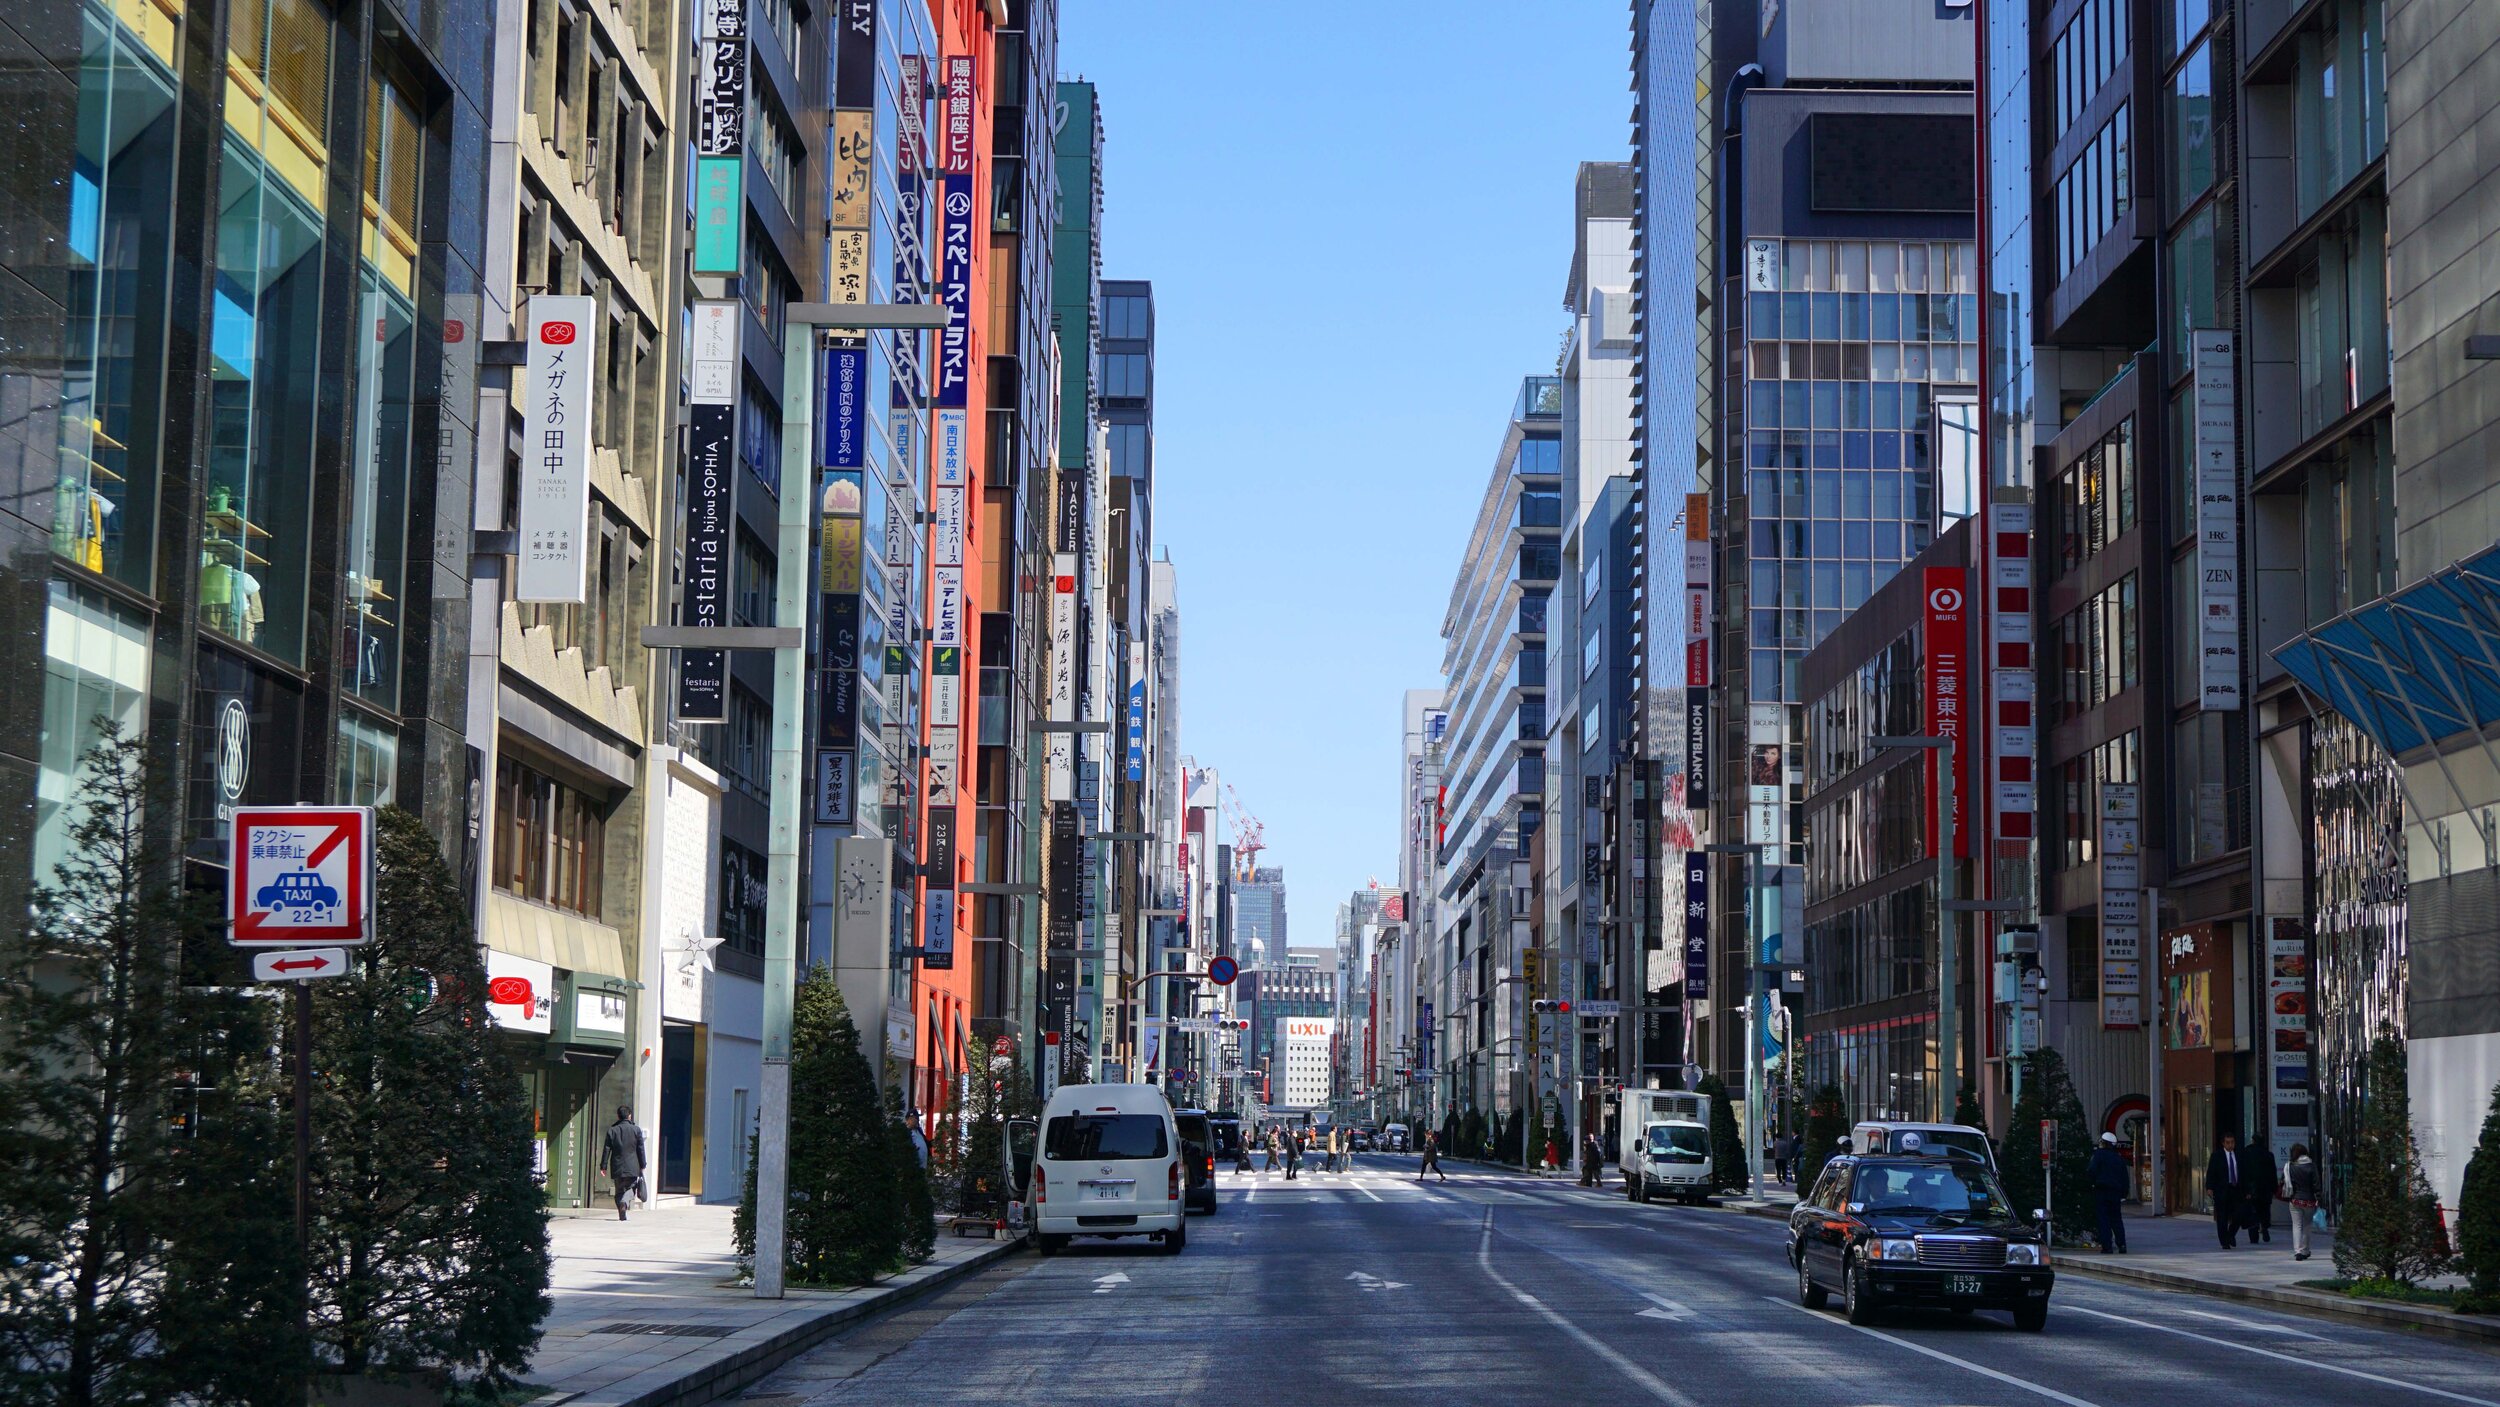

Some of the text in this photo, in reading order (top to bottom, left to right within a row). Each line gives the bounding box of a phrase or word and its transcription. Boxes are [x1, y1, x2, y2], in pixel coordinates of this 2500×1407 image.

[950, 59, 970, 170] 陽栄銀座ビル
[836, 213, 847, 222] 8F
[944, 223, 968, 388] スペーストラスト
[545, 350, 567, 474] メガネの田中
[839, 355, 855, 454] 迷宮の国のアリス
[946, 425, 958, 480] 南日本放送
[533, 530, 568, 538] メガネ
[697, 442, 718, 628] estaria bijou SOPHIA
[949, 489, 960, 563] ランドエスパース
[2209, 531, 2229, 540] HRC
[533, 541, 568, 550] 補聴器
[533, 553, 568, 561] コンタクト
[2206, 569, 2233, 582] ZEN
[940, 588, 955, 641] テレビ宮崎
[685, 677, 720, 687] festaria
[941, 677, 949, 723] 三井住友銀行
[934, 743, 954, 751] レイア
[1128, 697, 1143, 769] 名鉄観光
[1692, 704, 1703, 775] MONTBLANC
[827, 757, 843, 816] 星乃珈琲店
[252, 829, 306, 843] タクシー
[1763, 787, 1771, 862] 三井不動産リアルティ
[252, 845, 307, 859] 乗車禁止
[1587, 849, 1599, 882] ダンス
[283, 889, 313, 901] TAXI
[1689, 869, 1706, 952] 日新堂
[293, 911, 334, 923] 22-1
[933, 912, 945, 949] すし好
[1580, 1004, 1617, 1012] 銀座七丁目
[1290, 1023, 1326, 1036] LIXIL
[1954, 1281, 1981, 1293] 13-27
